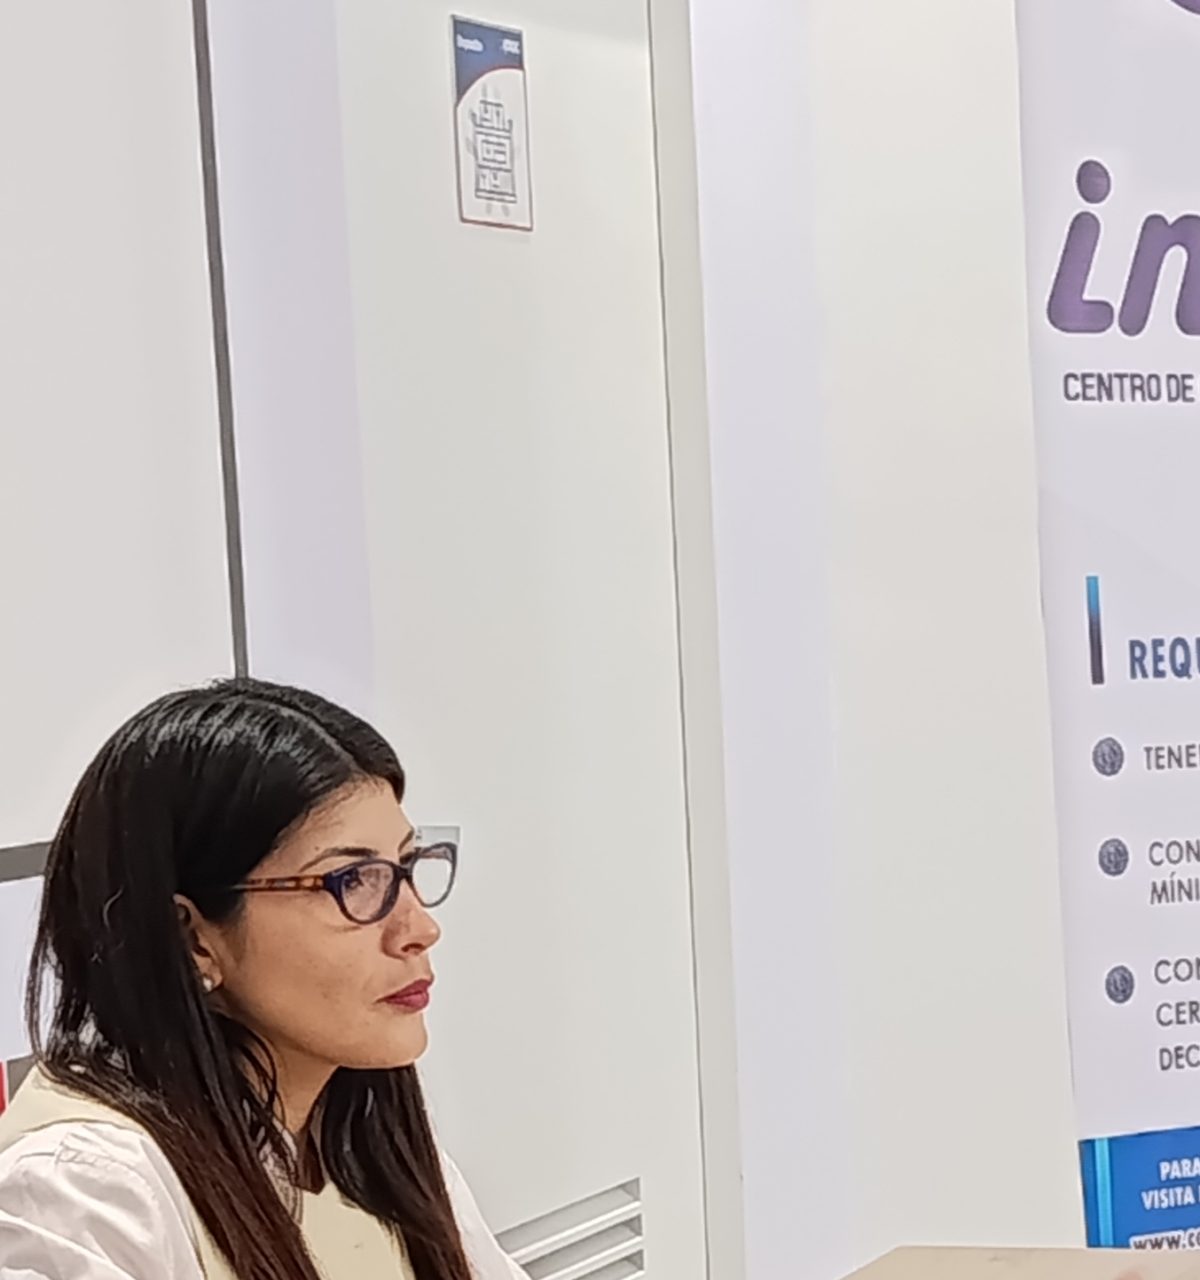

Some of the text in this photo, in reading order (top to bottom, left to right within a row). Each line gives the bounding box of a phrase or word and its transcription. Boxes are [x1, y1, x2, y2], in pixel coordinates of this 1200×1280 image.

[1064, 373, 1161, 403] CENTRO
[1166, 374, 1195, 403] DE
[1141, 1182, 1195, 1210] VISITA
